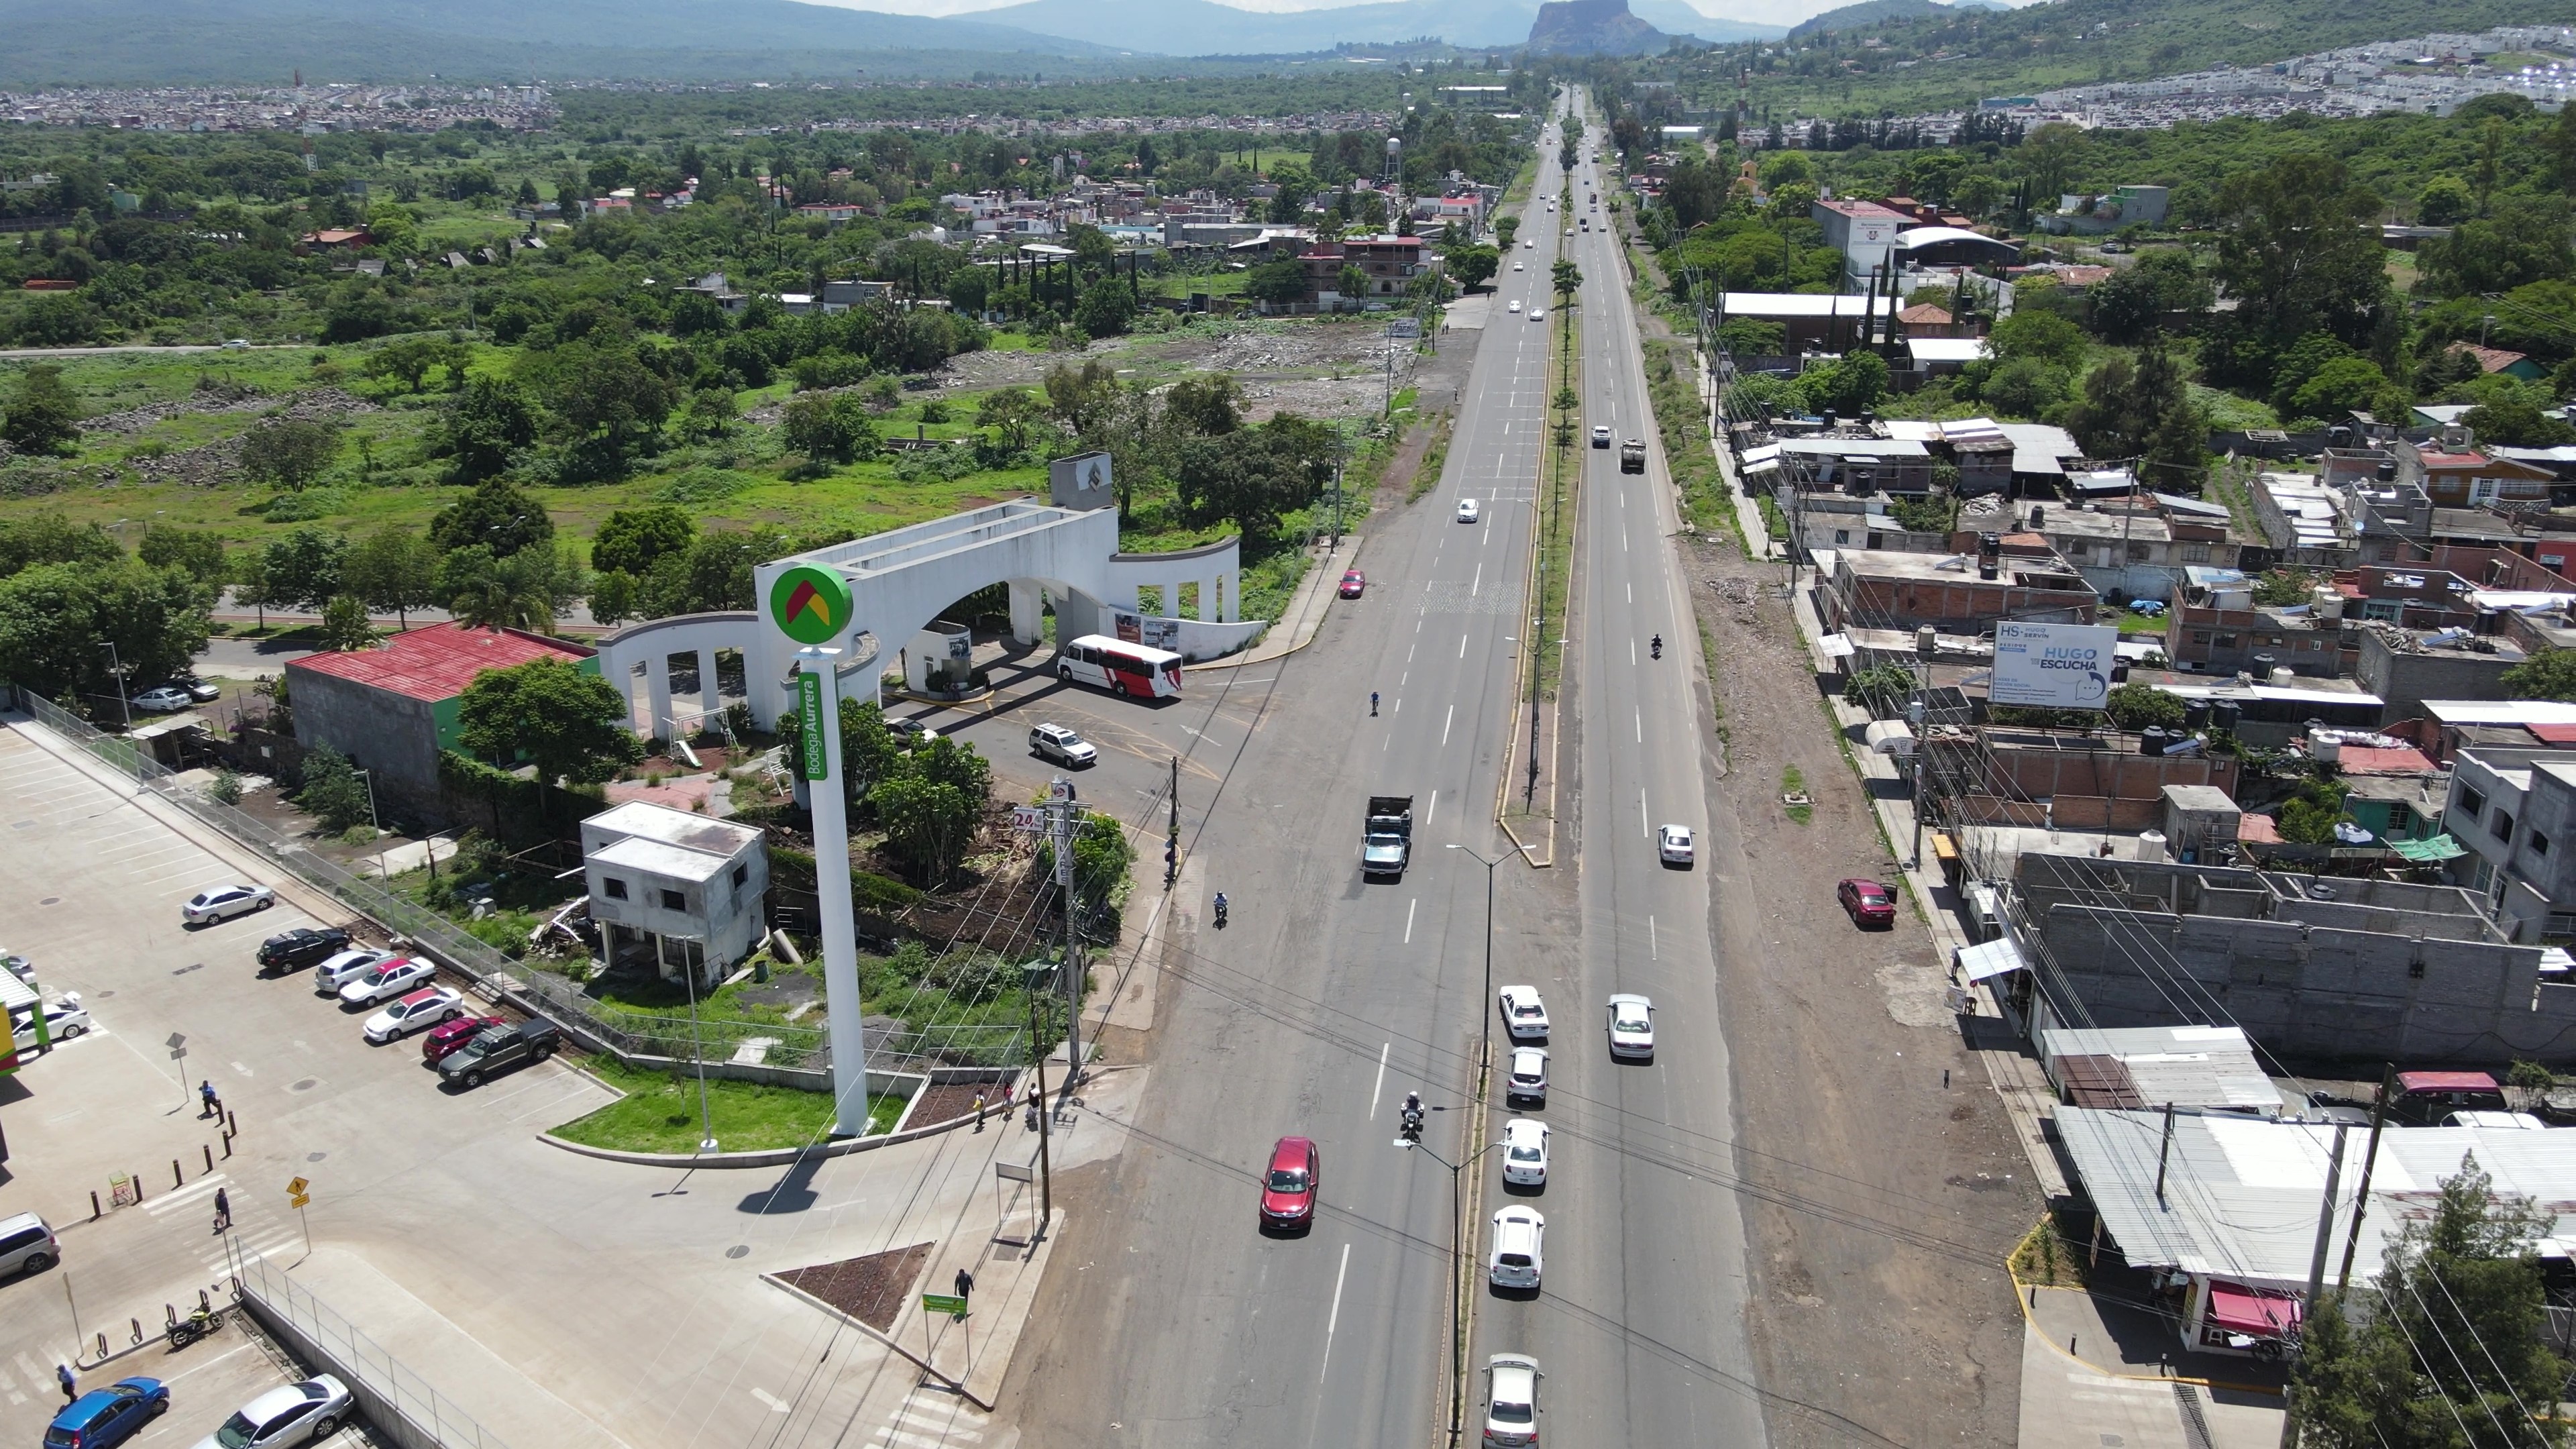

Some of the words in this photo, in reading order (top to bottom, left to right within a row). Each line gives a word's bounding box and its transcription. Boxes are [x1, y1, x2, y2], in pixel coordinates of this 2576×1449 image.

[2000, 625, 2019, 637] HS
[2045, 647, 2097, 660] HUGO
[2040, 659, 2097, 671] ESCUCHA
[804, 680, 816, 733] Aurrera
[806, 734, 822, 775] Bodega
[1014, 813, 1034, 827] 24
